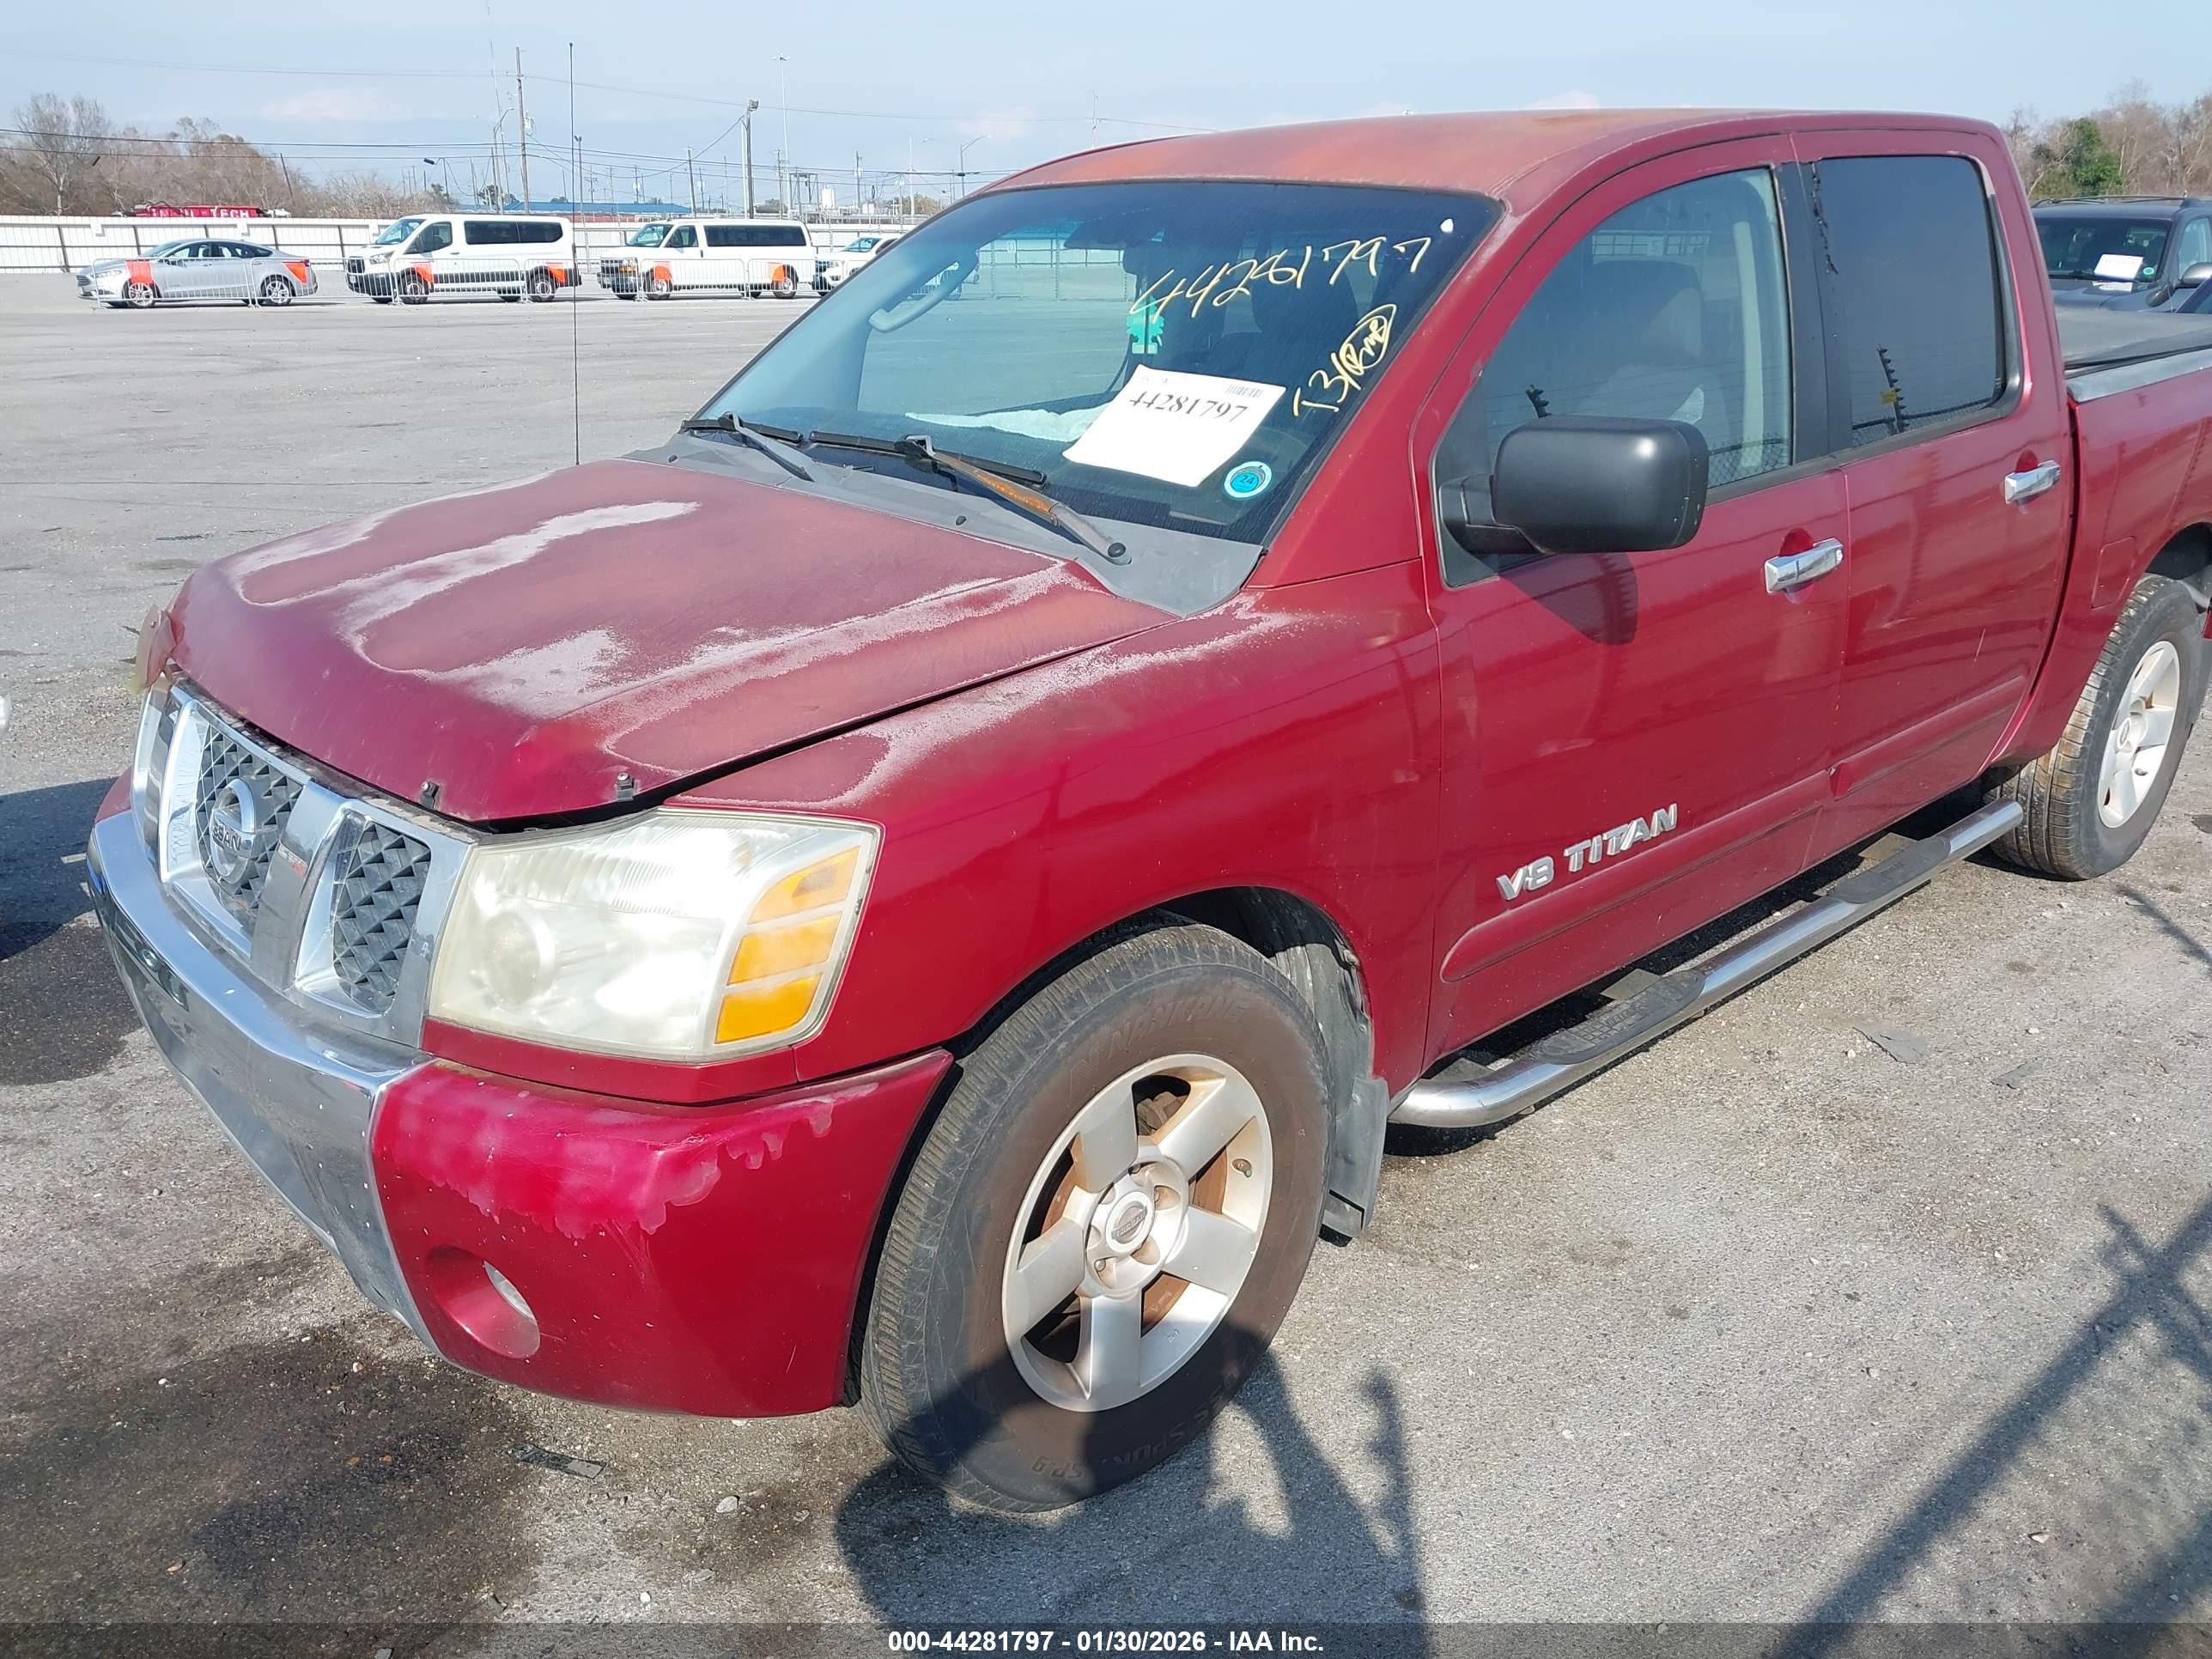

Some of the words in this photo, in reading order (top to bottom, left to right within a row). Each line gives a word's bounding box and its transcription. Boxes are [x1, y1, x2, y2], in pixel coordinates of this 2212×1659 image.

[1129, 391, 1249, 422] 44281797
[1497, 856, 1554, 901] V8
[1564, 803, 1678, 872] TITAN
